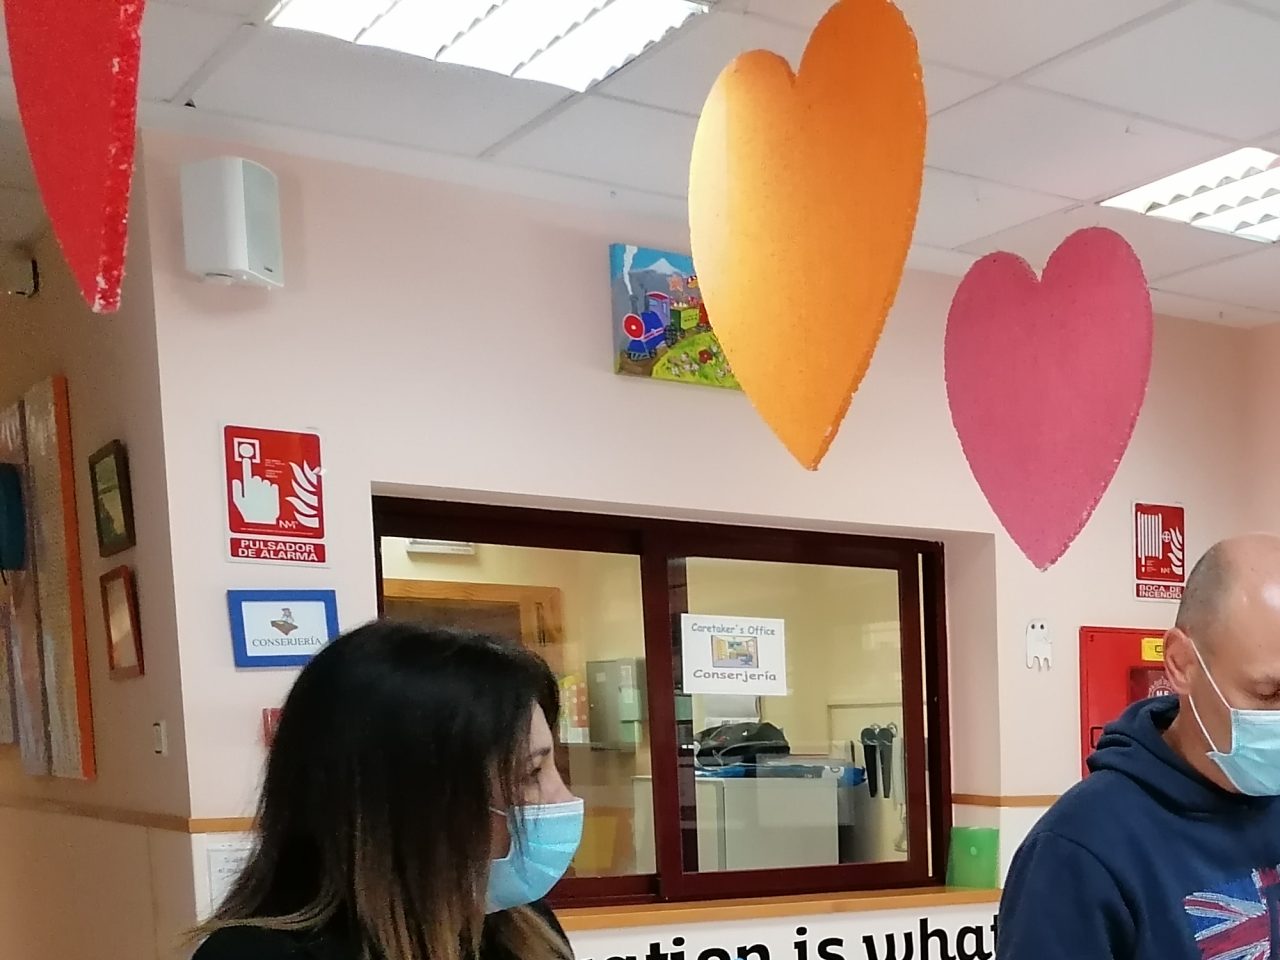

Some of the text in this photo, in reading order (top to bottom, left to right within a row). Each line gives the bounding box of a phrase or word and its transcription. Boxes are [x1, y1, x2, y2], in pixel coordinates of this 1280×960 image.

[241, 540, 315, 553] PULSADOR
[238, 548, 319, 562] DE ALARMA
[1139, 584, 1182, 593] BOCA DE
[1139, 590, 1182, 599] INCENDIO
[747, 625, 776, 636] Office
[252, 635, 322, 647] CONSERJERÍA
[692, 669, 777, 683] Conserjería
